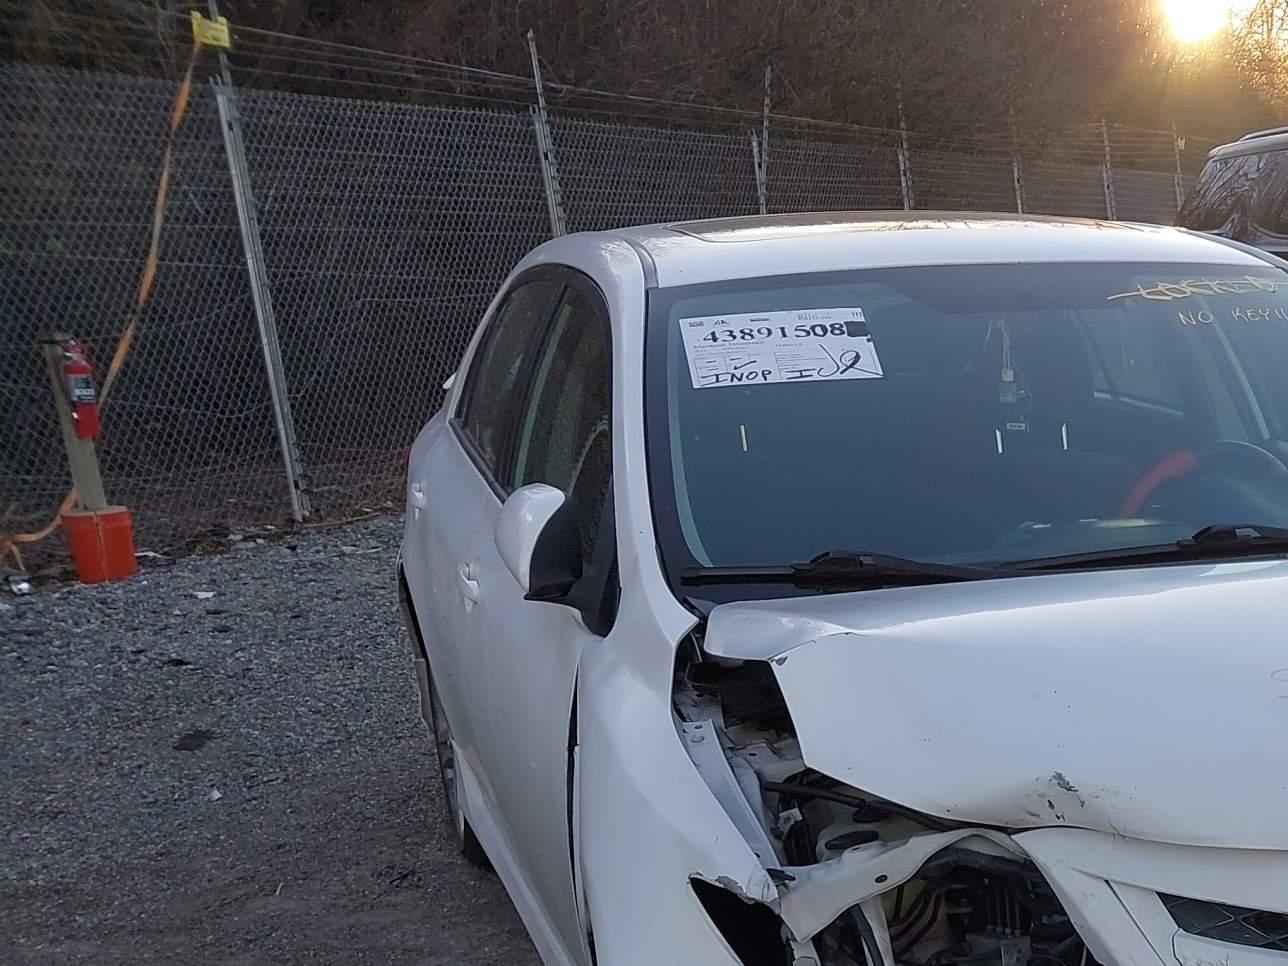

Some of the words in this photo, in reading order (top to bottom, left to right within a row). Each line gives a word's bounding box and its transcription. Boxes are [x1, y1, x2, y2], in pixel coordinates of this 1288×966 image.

[1177, 310, 1213, 326] NO
[703, 322, 846, 343] 43891508
[701, 369, 773, 387] INOP
